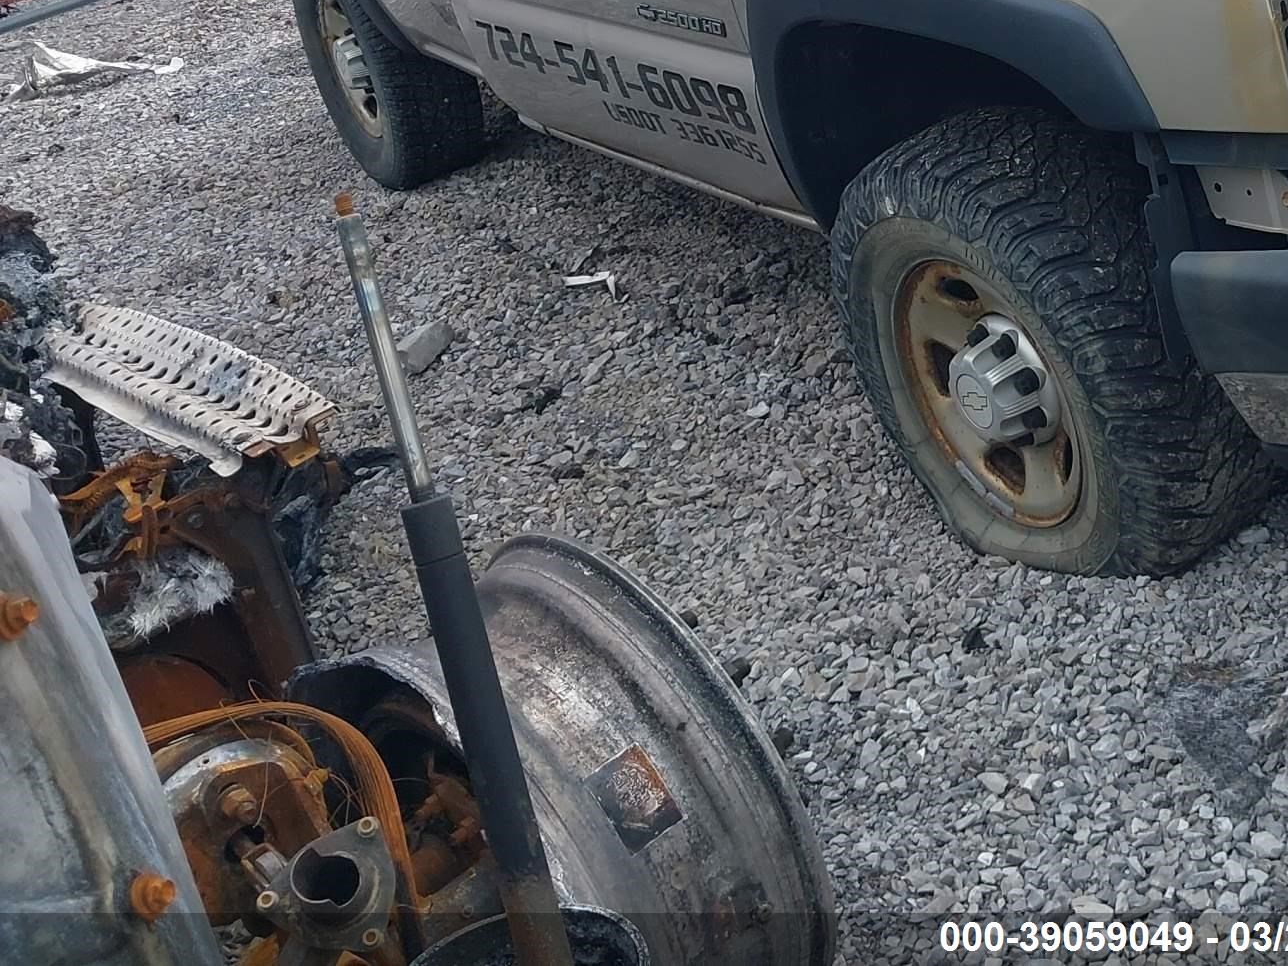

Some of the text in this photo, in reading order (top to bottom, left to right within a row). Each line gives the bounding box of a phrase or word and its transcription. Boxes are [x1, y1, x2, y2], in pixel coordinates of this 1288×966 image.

[658, 9, 723, 35] 2500 HD
[474, 20, 757, 135] 724-541-6098
[602, 100, 667, 135] USDOT
